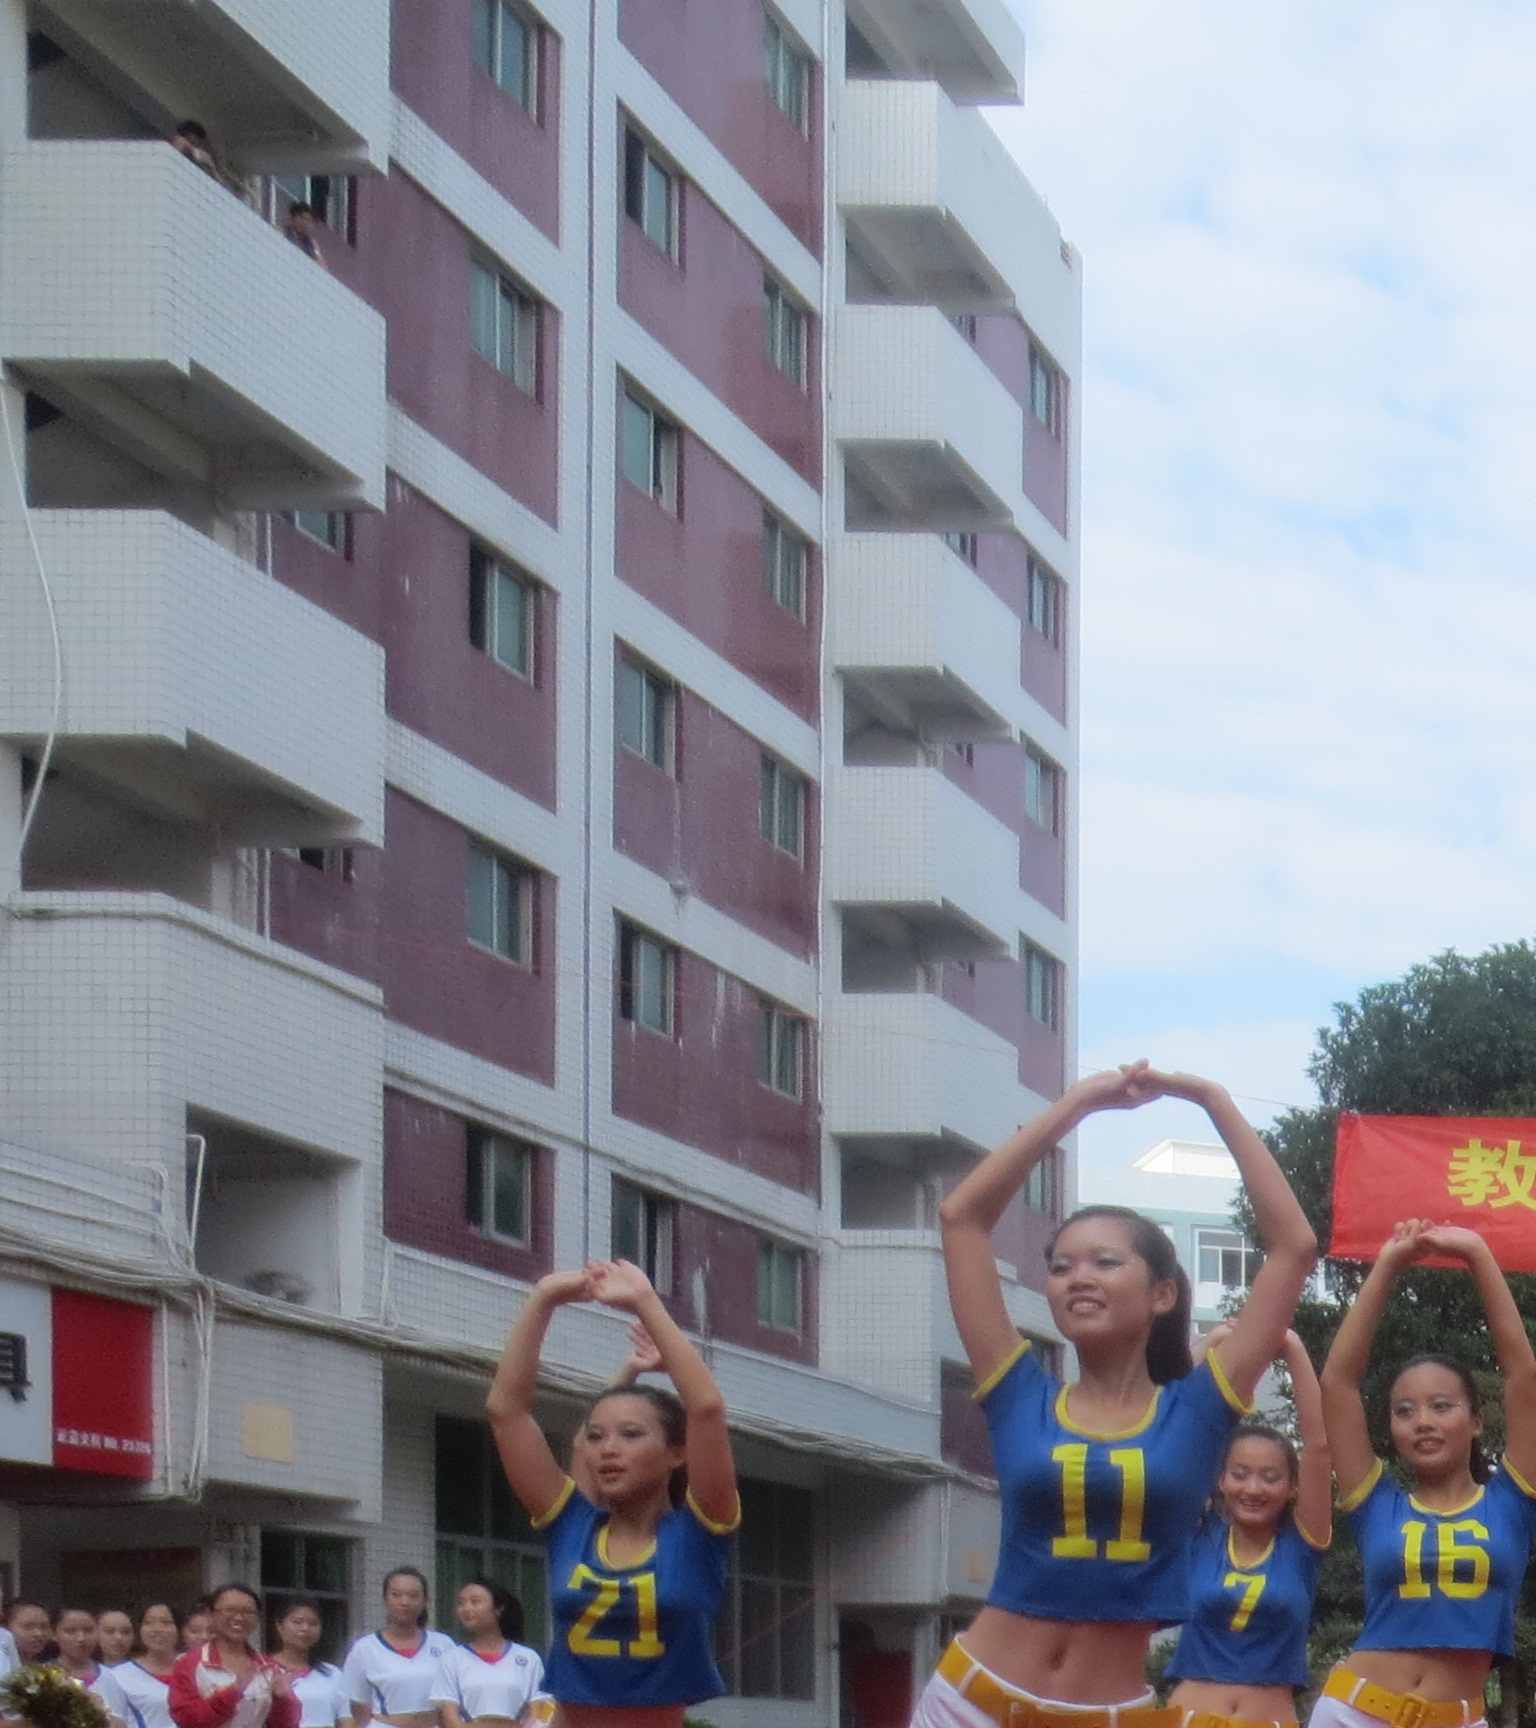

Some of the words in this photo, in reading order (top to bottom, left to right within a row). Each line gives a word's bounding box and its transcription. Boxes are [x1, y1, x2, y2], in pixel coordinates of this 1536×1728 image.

[1050, 1443, 1152, 1562] 11
[1223, 1575, 1266, 1632] 7
[1399, 1519, 1491, 1600] 16
[566, 1563, 665, 1659] 21
